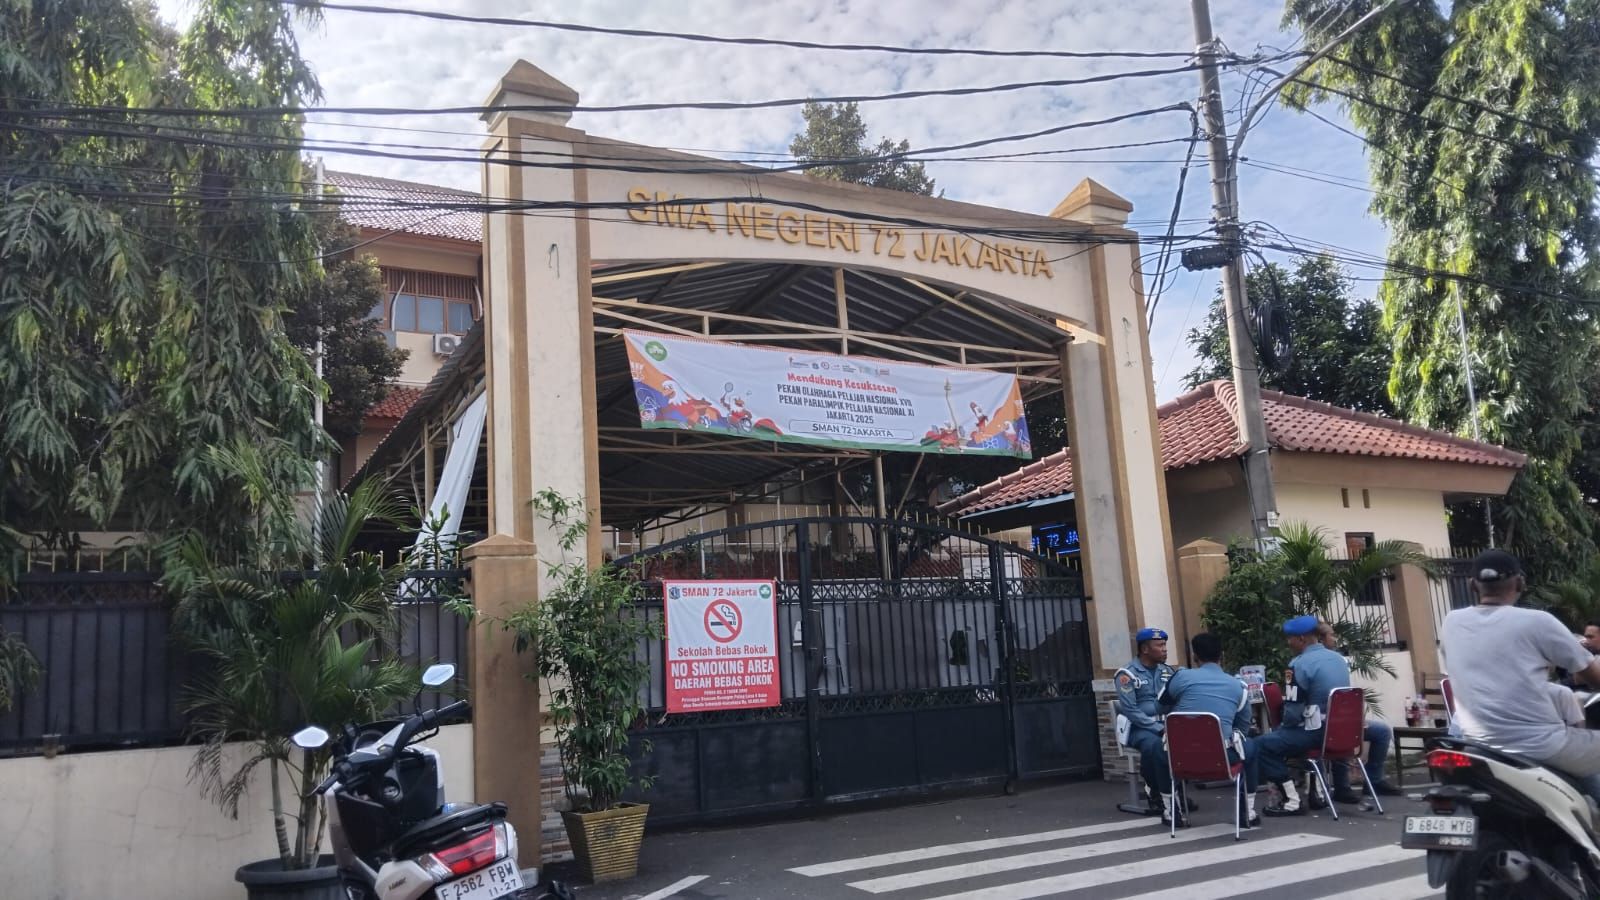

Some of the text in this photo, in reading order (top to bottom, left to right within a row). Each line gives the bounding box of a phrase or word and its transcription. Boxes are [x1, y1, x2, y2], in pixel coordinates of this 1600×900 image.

[627, 186, 1054, 279] SMA NEGERI 72 JAKARTA
[787, 372, 897, 394] Mendukung Kesuksesan
[777, 384, 801, 395] PEKAN
[802, 386, 837, 399] OLAHRAGA
[837, 391, 865, 403] PELAJAR
[865, 394, 899, 405] NASIONAL
[779, 395, 803, 406] PEKAN
[804, 397, 845, 410] PARALIMPIK
[845, 402, 873, 414] PELAJAR
[874, 405, 906, 417] NASIONAL
[826, 410, 874, 424] JAKARTA 2025
[812, 423, 894, 437] SMAN 72 JAKARTA
[682, 587, 757, 597] SMAN 72 Jakarta
[677, 644, 768, 657] Sekolah Bebas Rokok
[671, 658, 775, 677] NO SMOKING AREA
[674, 674, 773, 690] DAERAH BEBAS ROKOK
[441, 861, 514, 900] F 2562 FBW
